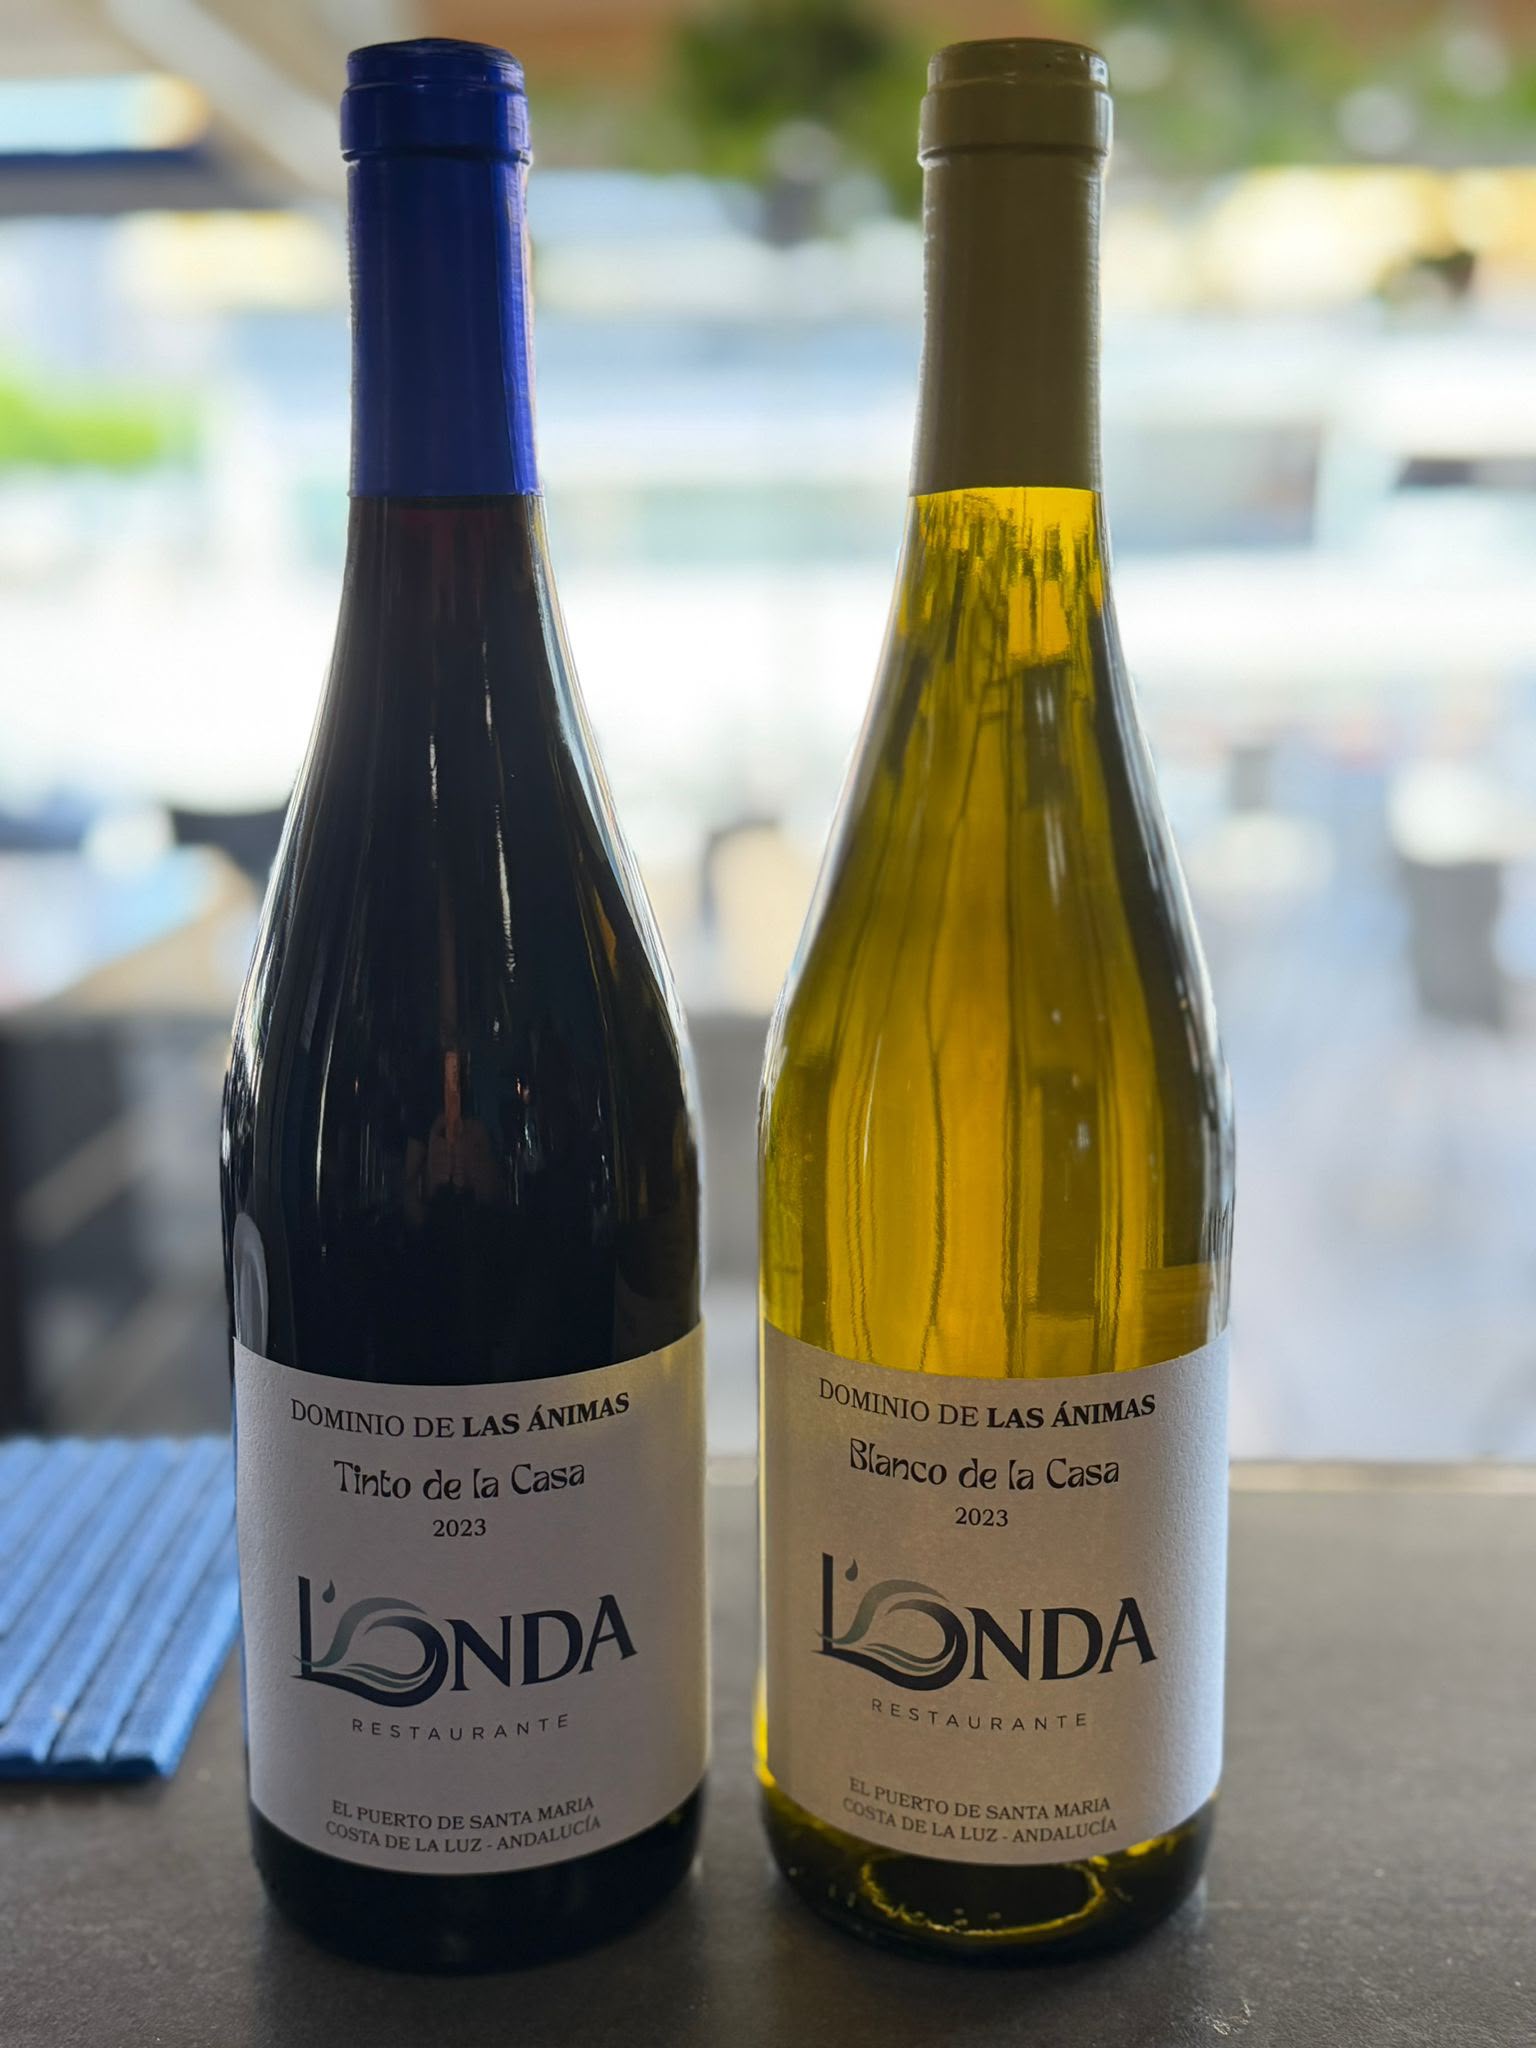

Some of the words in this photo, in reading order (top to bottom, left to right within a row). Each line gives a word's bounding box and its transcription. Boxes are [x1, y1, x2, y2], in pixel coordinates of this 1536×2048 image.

[291, 1398, 404, 1437] DOMINIO
[413, 1417, 455, 1438] DE
[462, 1413, 520, 1437] LAS
[526, 1392, 629, 1432] ÁNIMAS
[819, 1377, 929, 1422] DOMINIO
[937, 1404, 979, 1427] DE
[986, 1408, 1044, 1429] LAS
[1050, 1394, 1155, 1427] ÁNIMAS
[334, 1460, 411, 1499] Tinto
[423, 1469, 461, 1500] de
[473, 1468, 499, 1499] la
[511, 1463, 584, 1495] Casa
[850, 1438, 947, 1485] Blanco
[958, 1458, 997, 1490] de
[1009, 1460, 1034, 1490] la
[1046, 1458, 1119, 1489] Casa
[433, 1518, 486, 1537] 2023
[955, 1507, 1008, 1527] 2023
[353, 1714, 567, 1741] RESTAURANTE
[872, 1699, 1086, 1731] RESTAURANTE
[333, 1800, 352, 1818] EL
[357, 1807, 432, 1829] PUERTO
[437, 1816, 465, 1830] DE
[470, 1811, 533, 1829] SANTA
[538, 1796, 594, 1822] MARIA
[850, 1777, 871, 1798] EL
[875, 1786, 949, 1815] PUERTO
[954, 1803, 981, 1818] DE
[986, 1805, 1049, 1820] SANTA
[1054, 1797, 1110, 1818] MARIA
[326, 1821, 380, 1846] COSTA
[385, 1834, 410, 1851] DE
[416, 1838, 439, 1852] LA
[445, 1838, 482, 1853] LUZ
[497, 1815, 600, 1850] ANDALUCÍA
[844, 1796, 897, 1827] COSTA
[902, 1816, 927, 1833] DE
[932, 1822, 955, 1839] LA
[961, 1826, 997, 1842] LUZ
[1012, 1815, 1116, 1843] ANDALUCÍA
